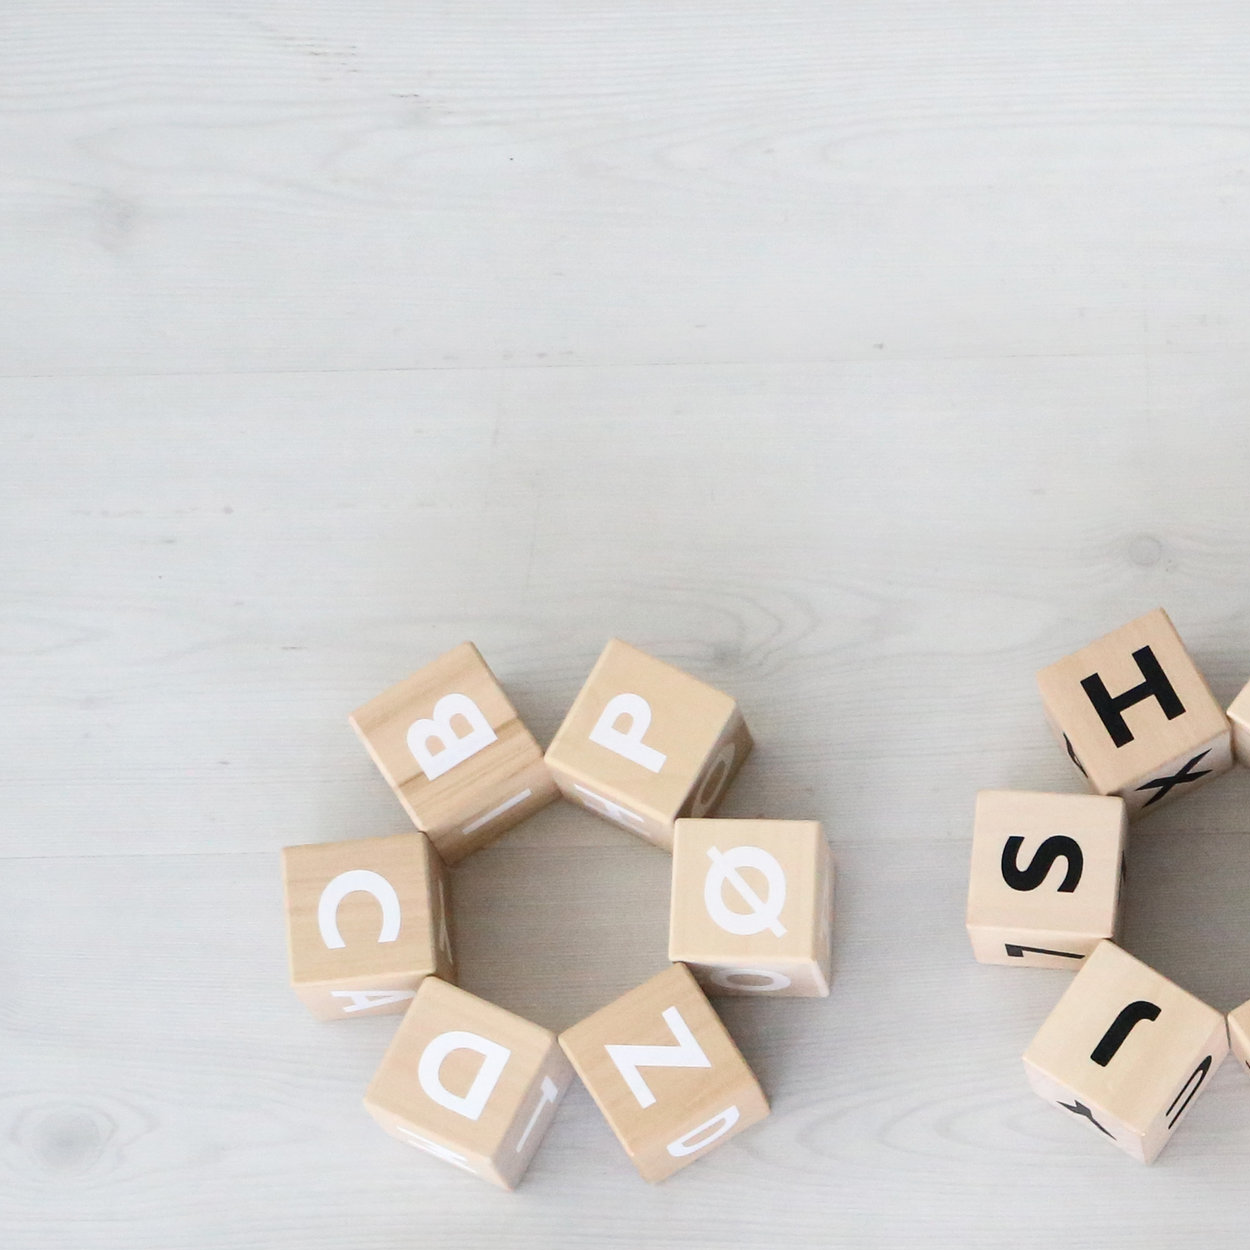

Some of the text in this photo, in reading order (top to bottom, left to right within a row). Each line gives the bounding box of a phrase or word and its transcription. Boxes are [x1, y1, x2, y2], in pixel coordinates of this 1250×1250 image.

[406, 693, 497, 780] B
[589, 693, 667, 773] P
[1080, 646, 1186, 748] H
[703, 845, 788, 939] Ø
[1001, 836, 1083, 892] S
[317, 870, 401, 949] C
[1091, 1001, 1161, 1067] J
[418, 1031, 512, 1122] D
